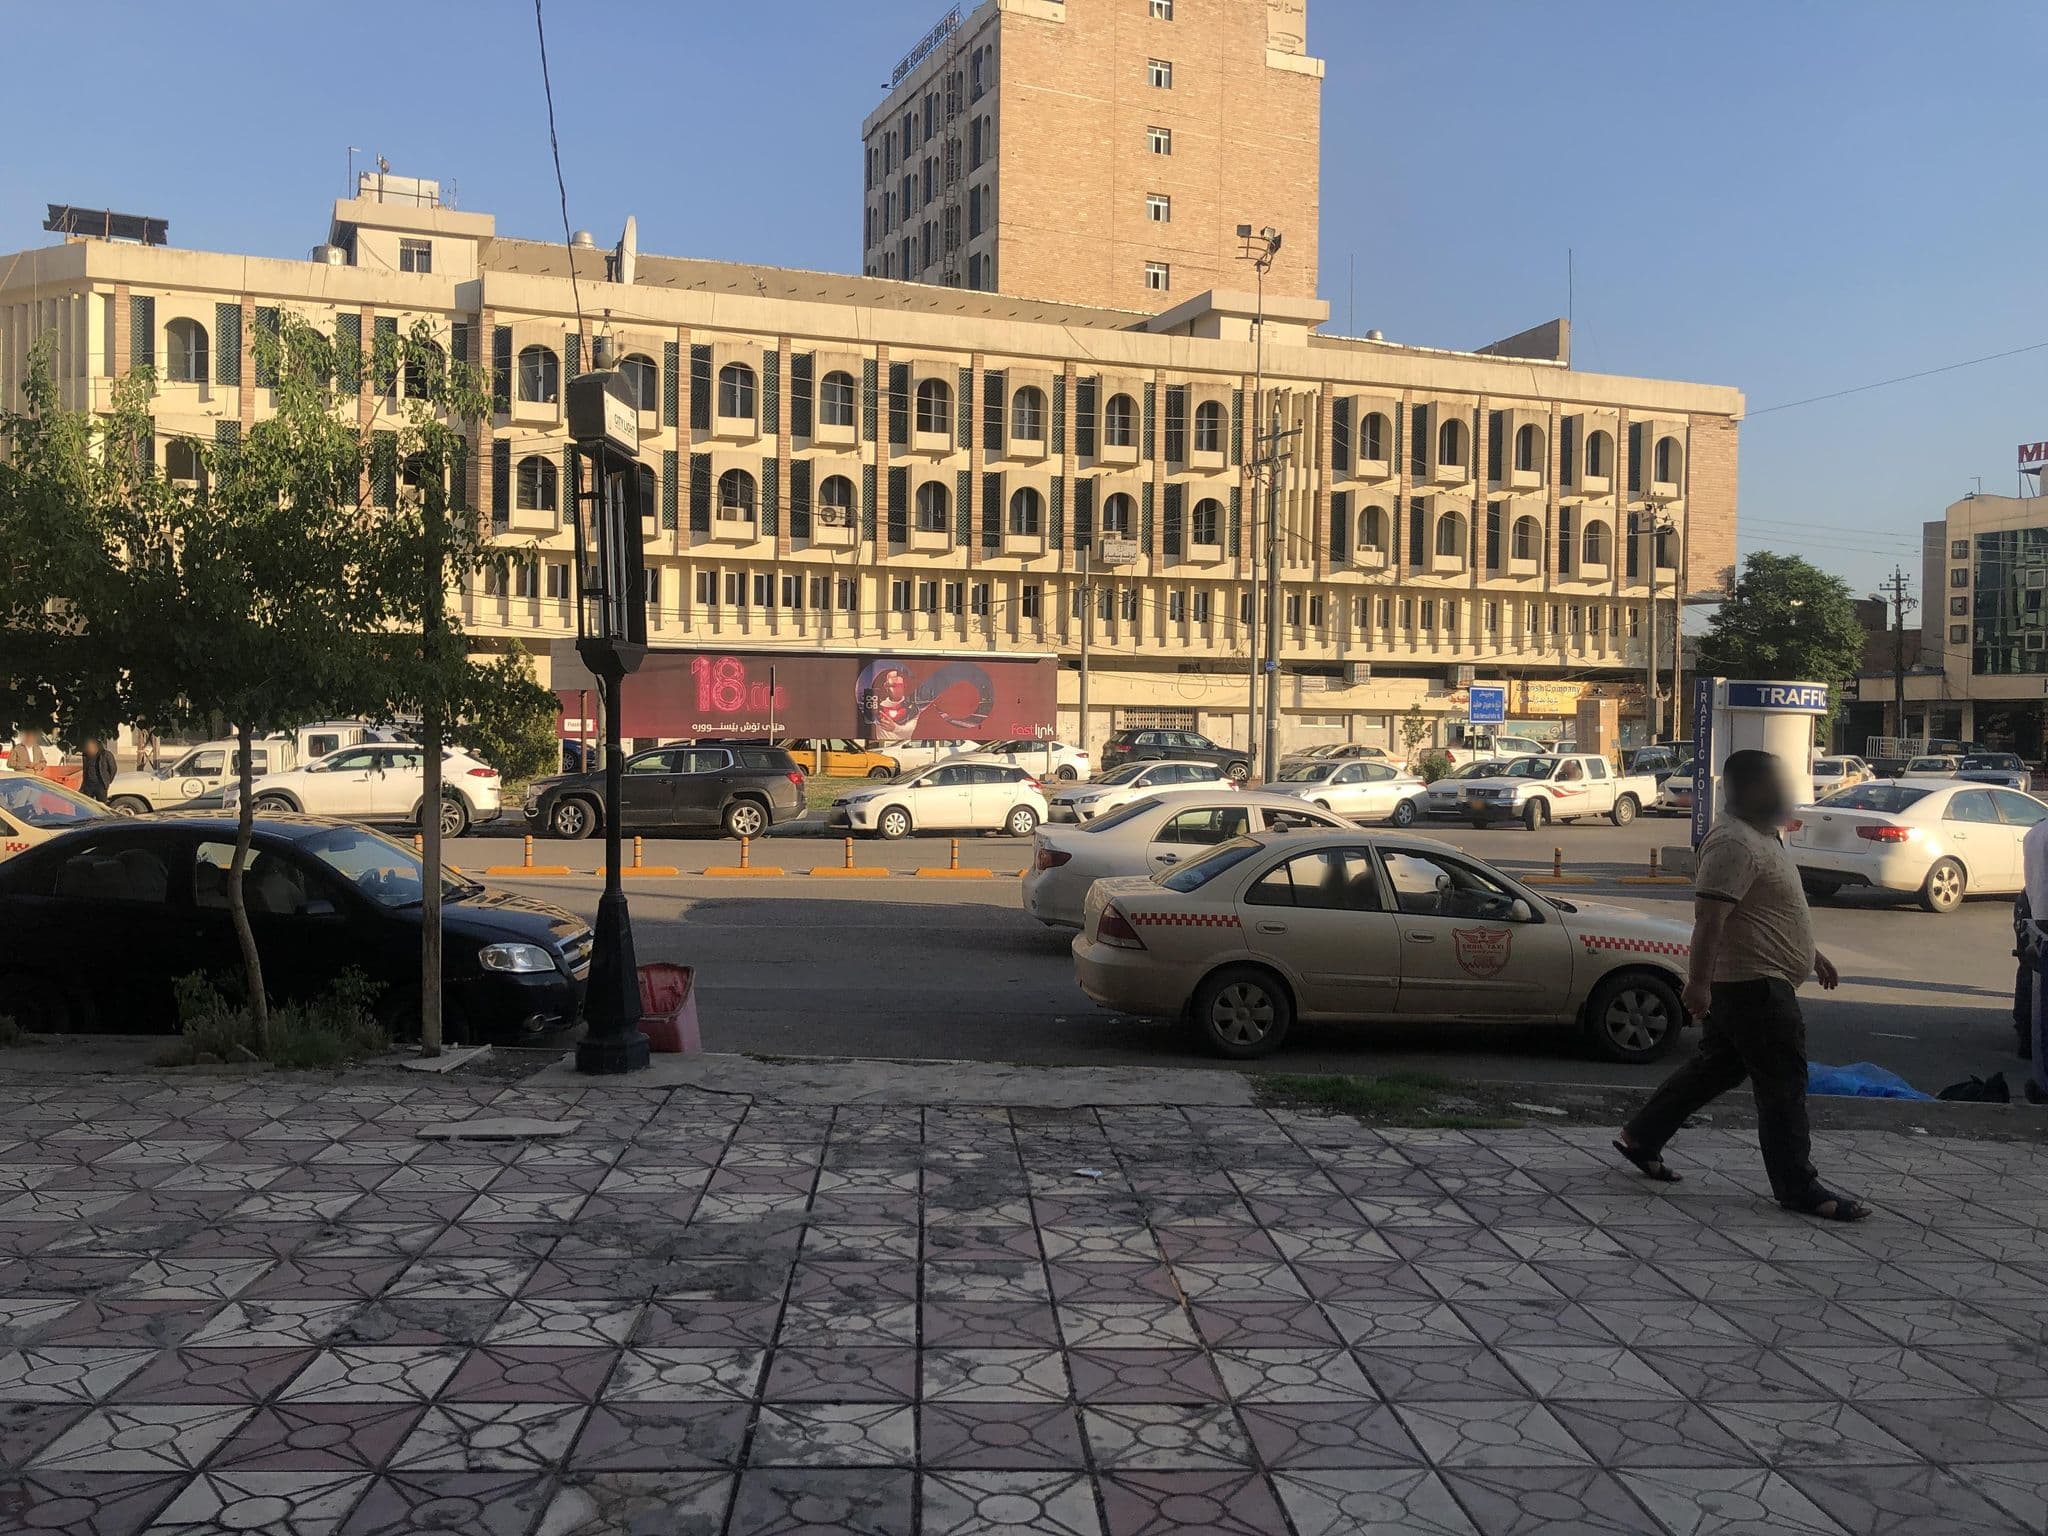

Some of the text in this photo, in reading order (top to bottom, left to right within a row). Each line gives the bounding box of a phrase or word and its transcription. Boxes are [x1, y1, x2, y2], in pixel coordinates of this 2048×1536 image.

[1699, 680, 1708, 760] TRAFFIC
[1756, 687, 1826, 707] TRAFFIC
[1696, 768, 1706, 836] POLICE
